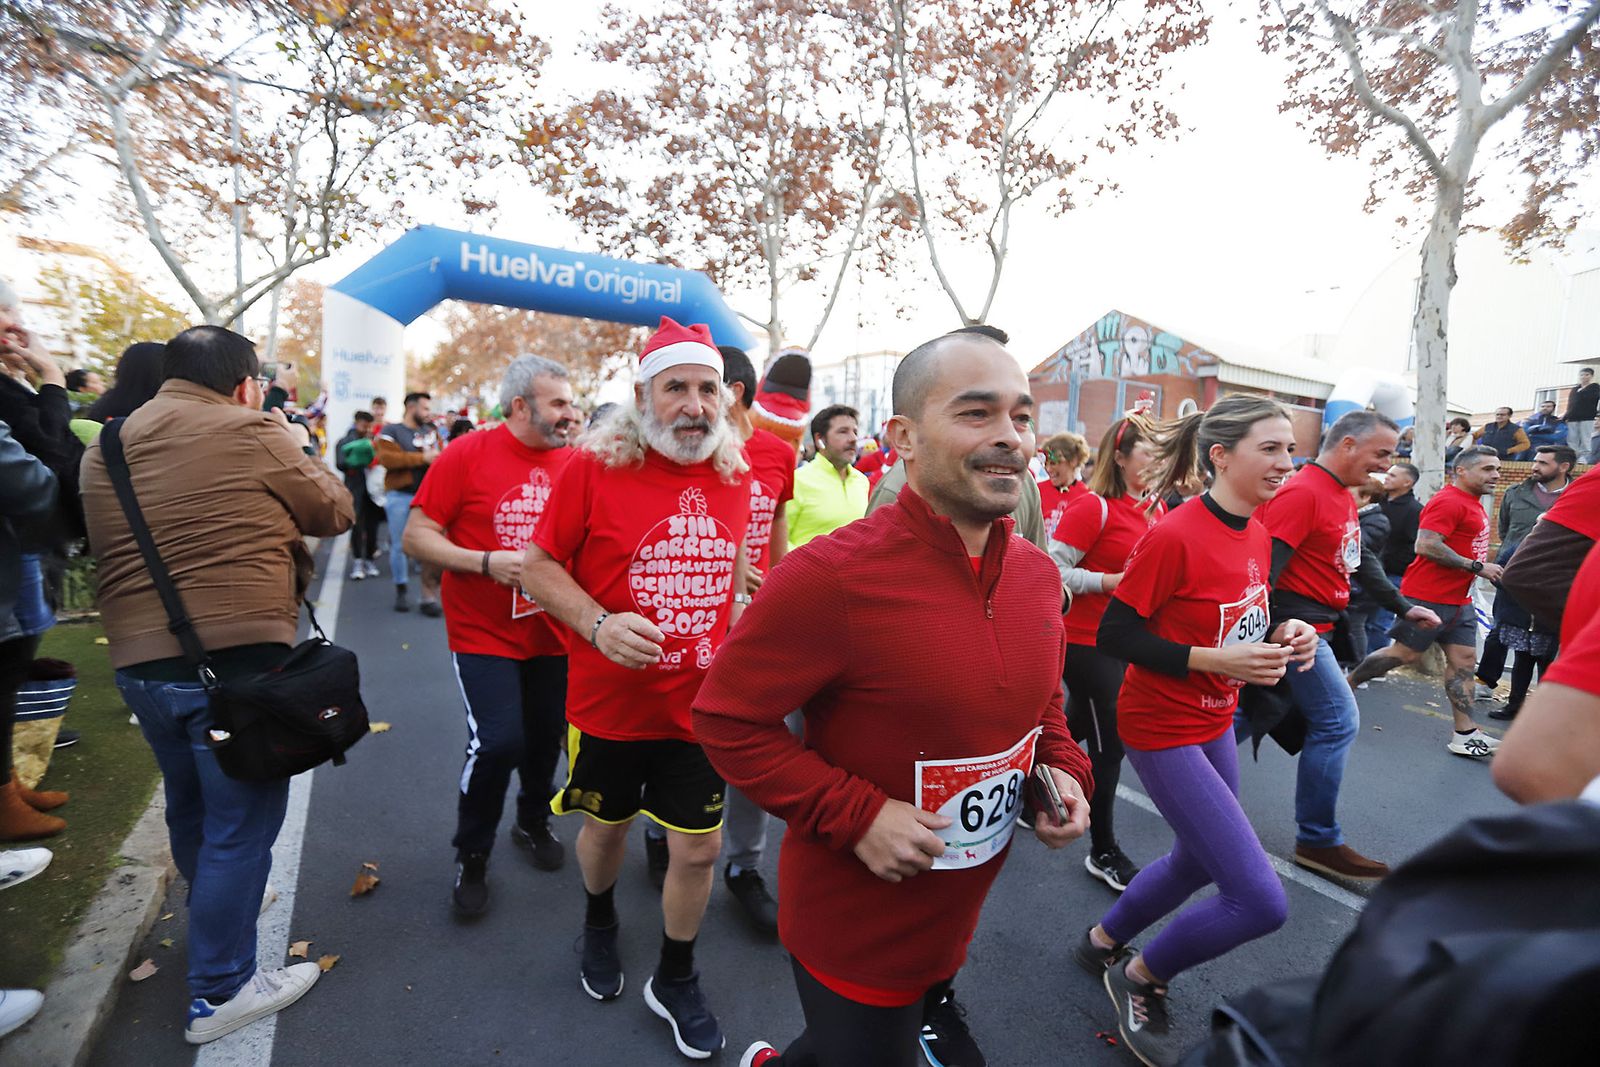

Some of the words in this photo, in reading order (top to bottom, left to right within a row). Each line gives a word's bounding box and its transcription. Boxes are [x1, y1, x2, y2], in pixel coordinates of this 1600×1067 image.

[460, 241, 576, 288] Huelva
[584, 267, 683, 304] original
[500, 498, 545, 513] CARR
[667, 516, 718, 538] XIII
[639, 535, 737, 560] CARRERA
[629, 559, 670, 574] SAN
[671, 559, 733, 574] SILVESTR
[631, 575, 658, 592] DE
[636, 592, 665, 609] 30
[666, 597, 682, 610] DE
[656, 608, 718, 635] 2023
[960, 772, 1019, 833] 628
